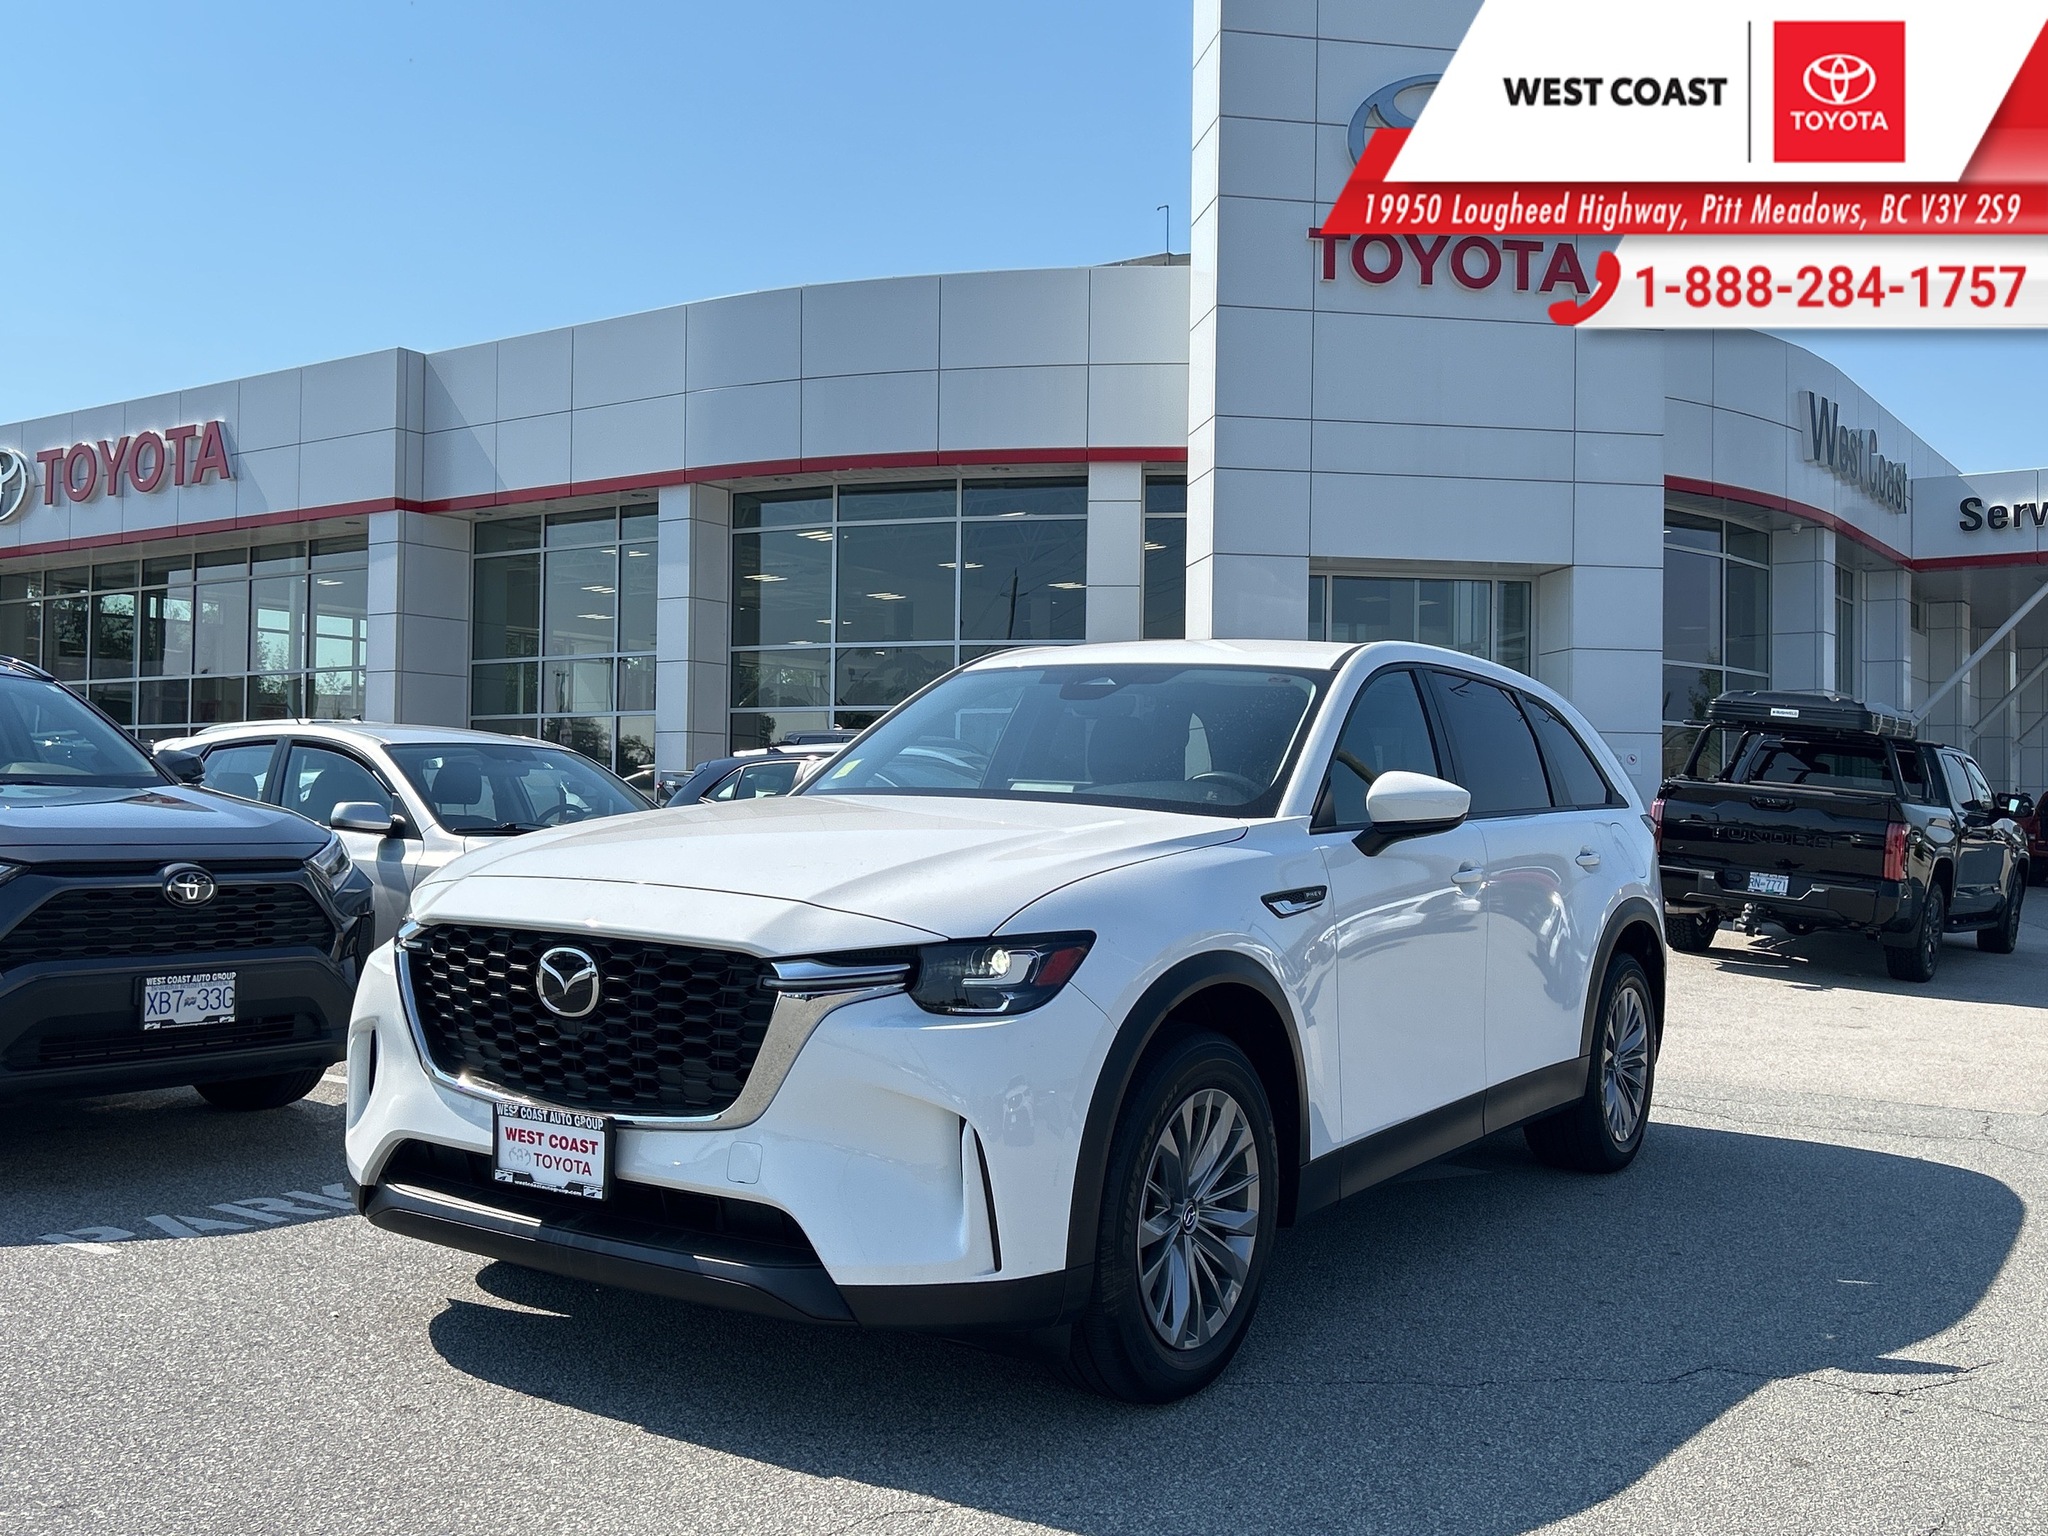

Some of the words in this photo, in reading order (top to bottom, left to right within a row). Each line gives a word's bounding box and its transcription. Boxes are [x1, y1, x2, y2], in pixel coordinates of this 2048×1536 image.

[1307, 227, 1591, 296] TOYOTA
[36, 420, 235, 506] TOYOTA
[1800, 390, 1864, 480] West
[1867, 428, 1908, 515] Coast
[1958, 496, 2048, 532] Serv
[146, 977, 166, 985] WEST
[167, 976, 191, 984] COAST
[192, 974, 211, 982] AUTO
[212, 972, 237, 981] GROUP
[146, 989, 184, 1016] XB7
[520, 1107, 548, 1122] COAST
[549, 1111, 572, 1125] AUTO
[574, 1115, 604, 1130] GROUP
[505, 1127, 545, 1146] WEST
[549, 1134, 599, 1155] COAST
[533, 1152, 593, 1177] TOYOTA
